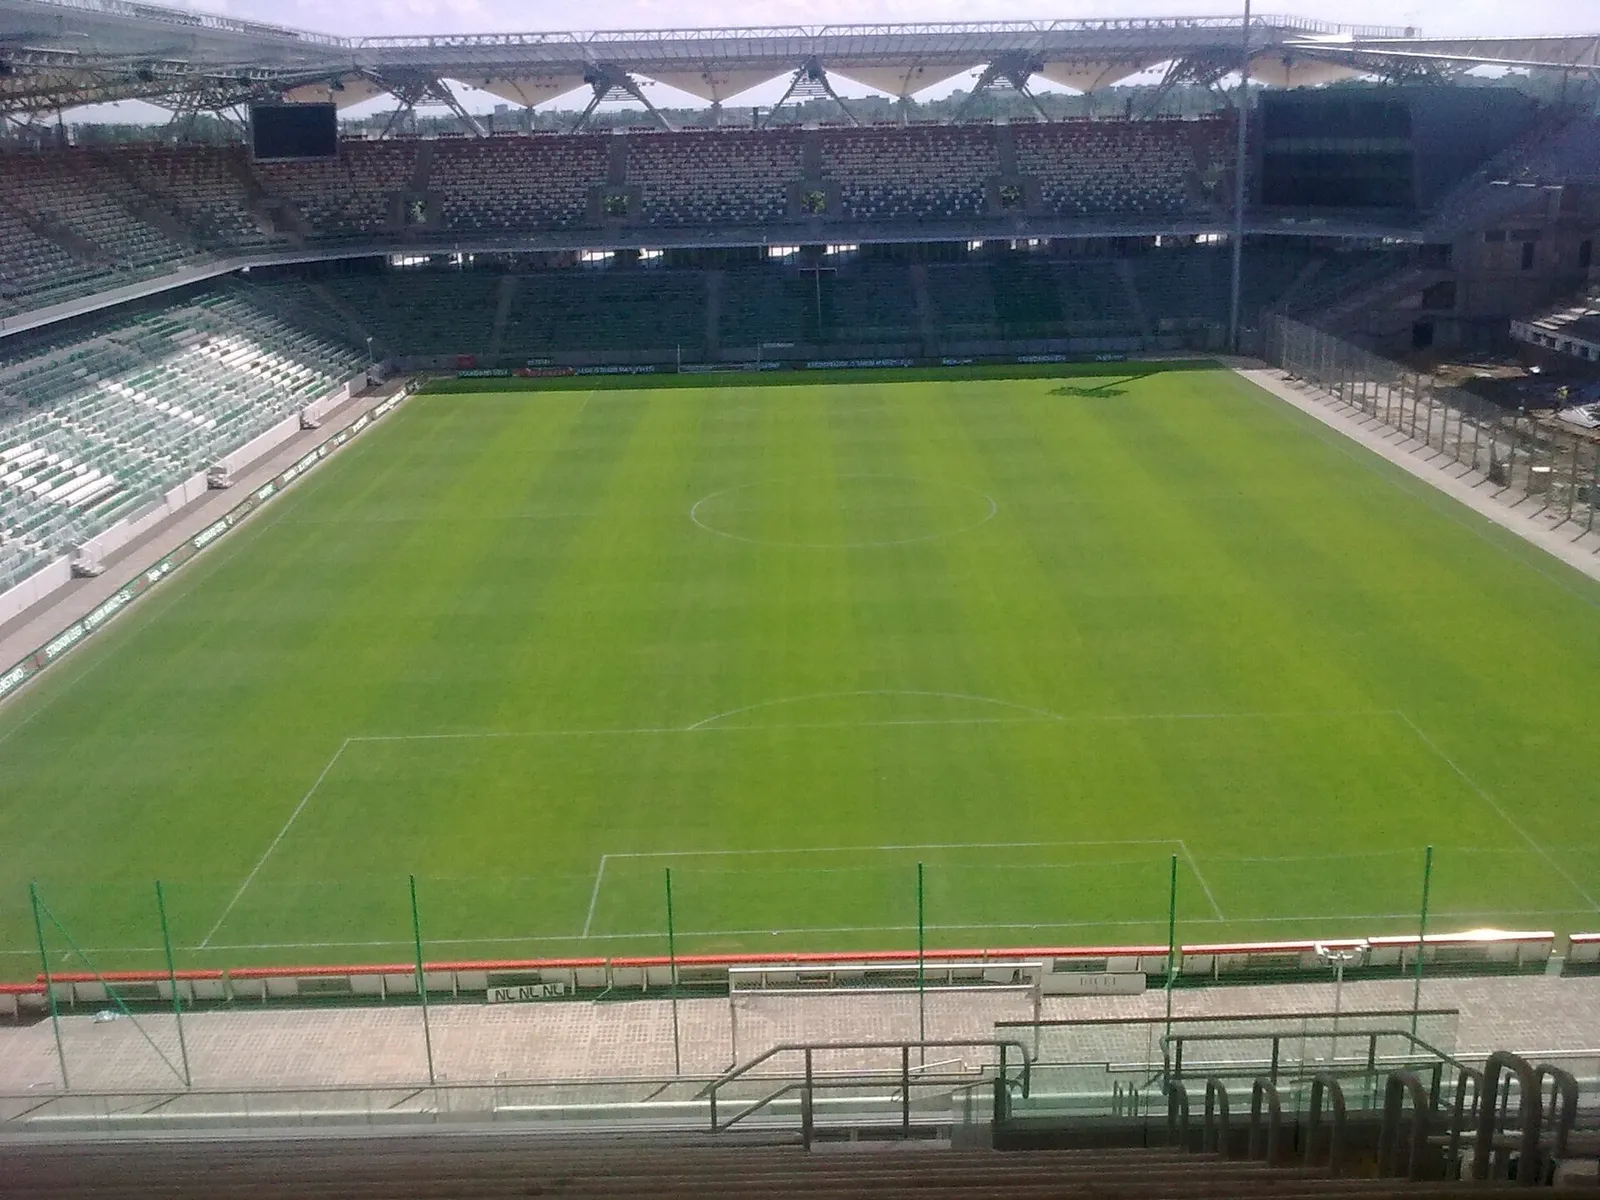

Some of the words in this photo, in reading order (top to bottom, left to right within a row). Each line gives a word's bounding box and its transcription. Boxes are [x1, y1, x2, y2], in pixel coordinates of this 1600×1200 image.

[495, 990, 516, 1001] NL
[519, 987, 540, 999] NL
[543, 984, 563, 996] NL
